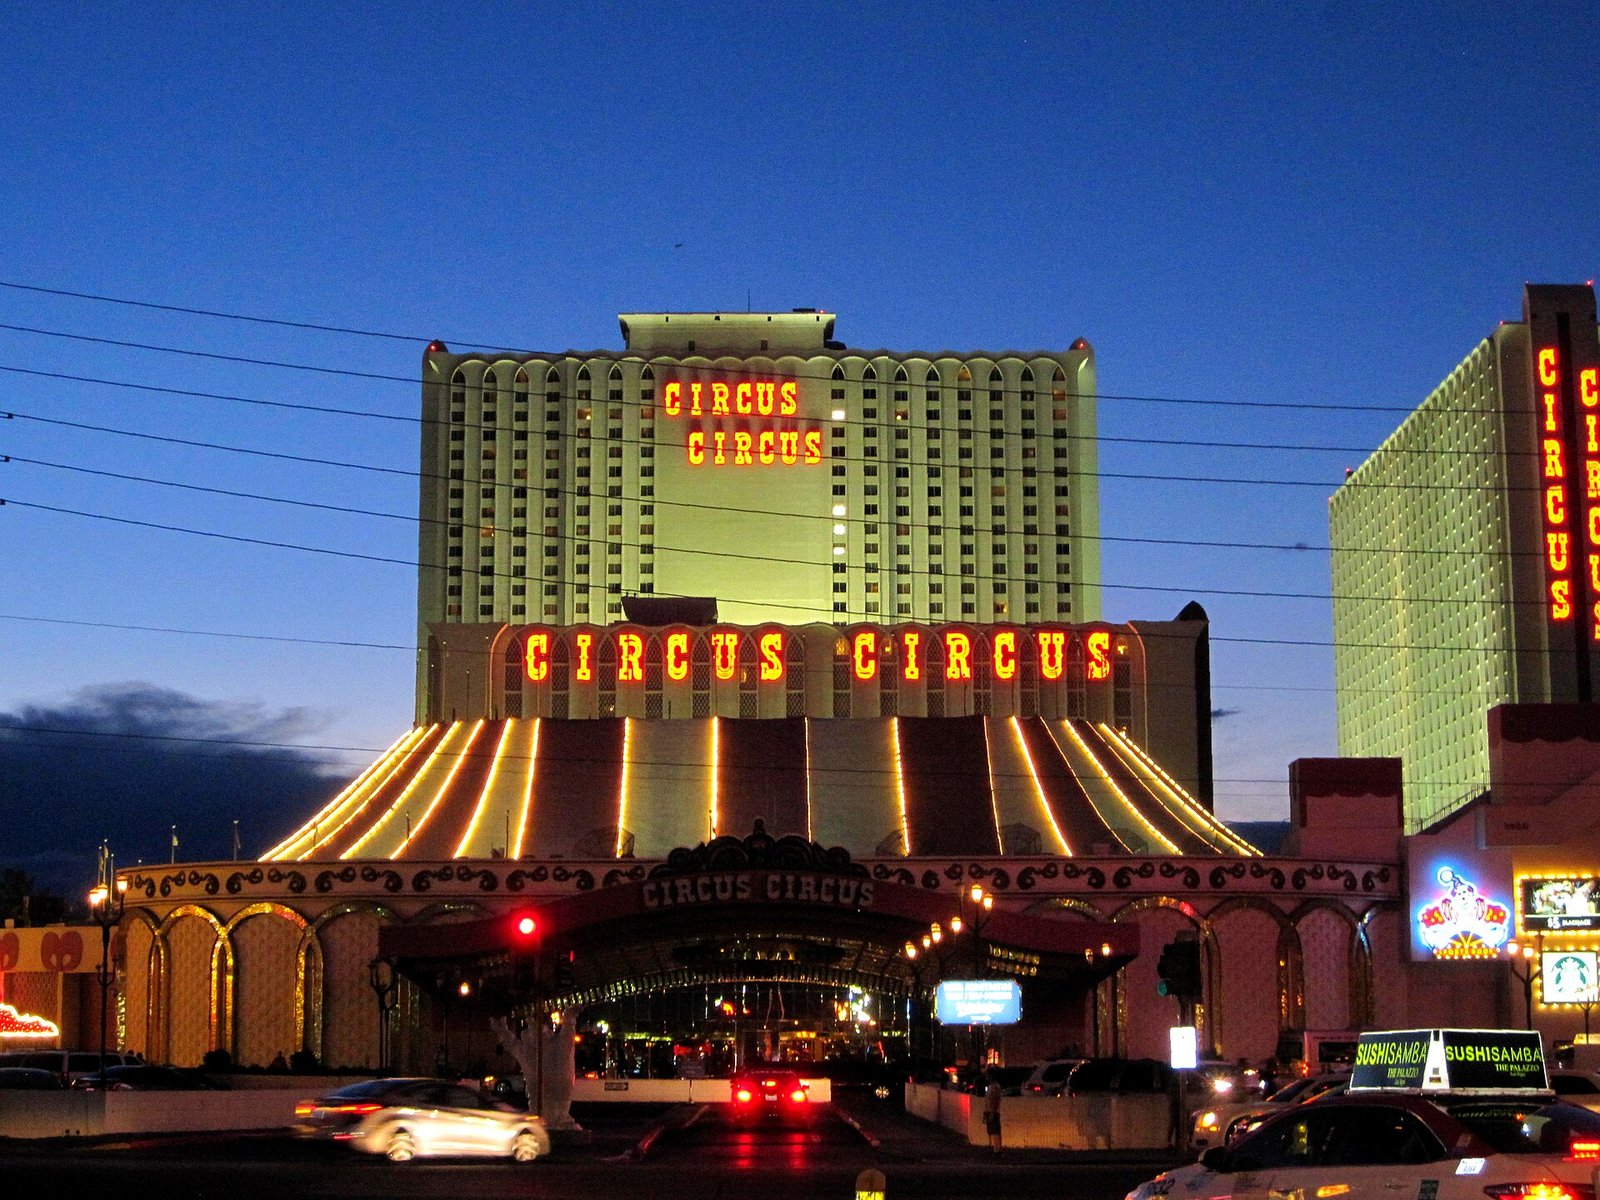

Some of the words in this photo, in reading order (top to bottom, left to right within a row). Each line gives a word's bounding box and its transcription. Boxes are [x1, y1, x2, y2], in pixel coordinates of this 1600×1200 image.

[664, 381, 798, 417] CIRCUS
[687, 430, 823, 466] CIRCUS
[1537, 347, 1571, 621] CIRCUS
[525, 632, 783, 682] CIRCUS
[852, 631, 1111, 681] CIRCUS
[642, 874, 750, 907] CIRCUS
[766, 873, 874, 907] CIRCUS
[1356, 1041, 1428, 1066] SUSHISAMBA
[1445, 1045, 1543, 1062] SUSHISAMBA
[1494, 1063, 1509, 1072] THE
[1509, 1063, 1540, 1072] PALAZZO
